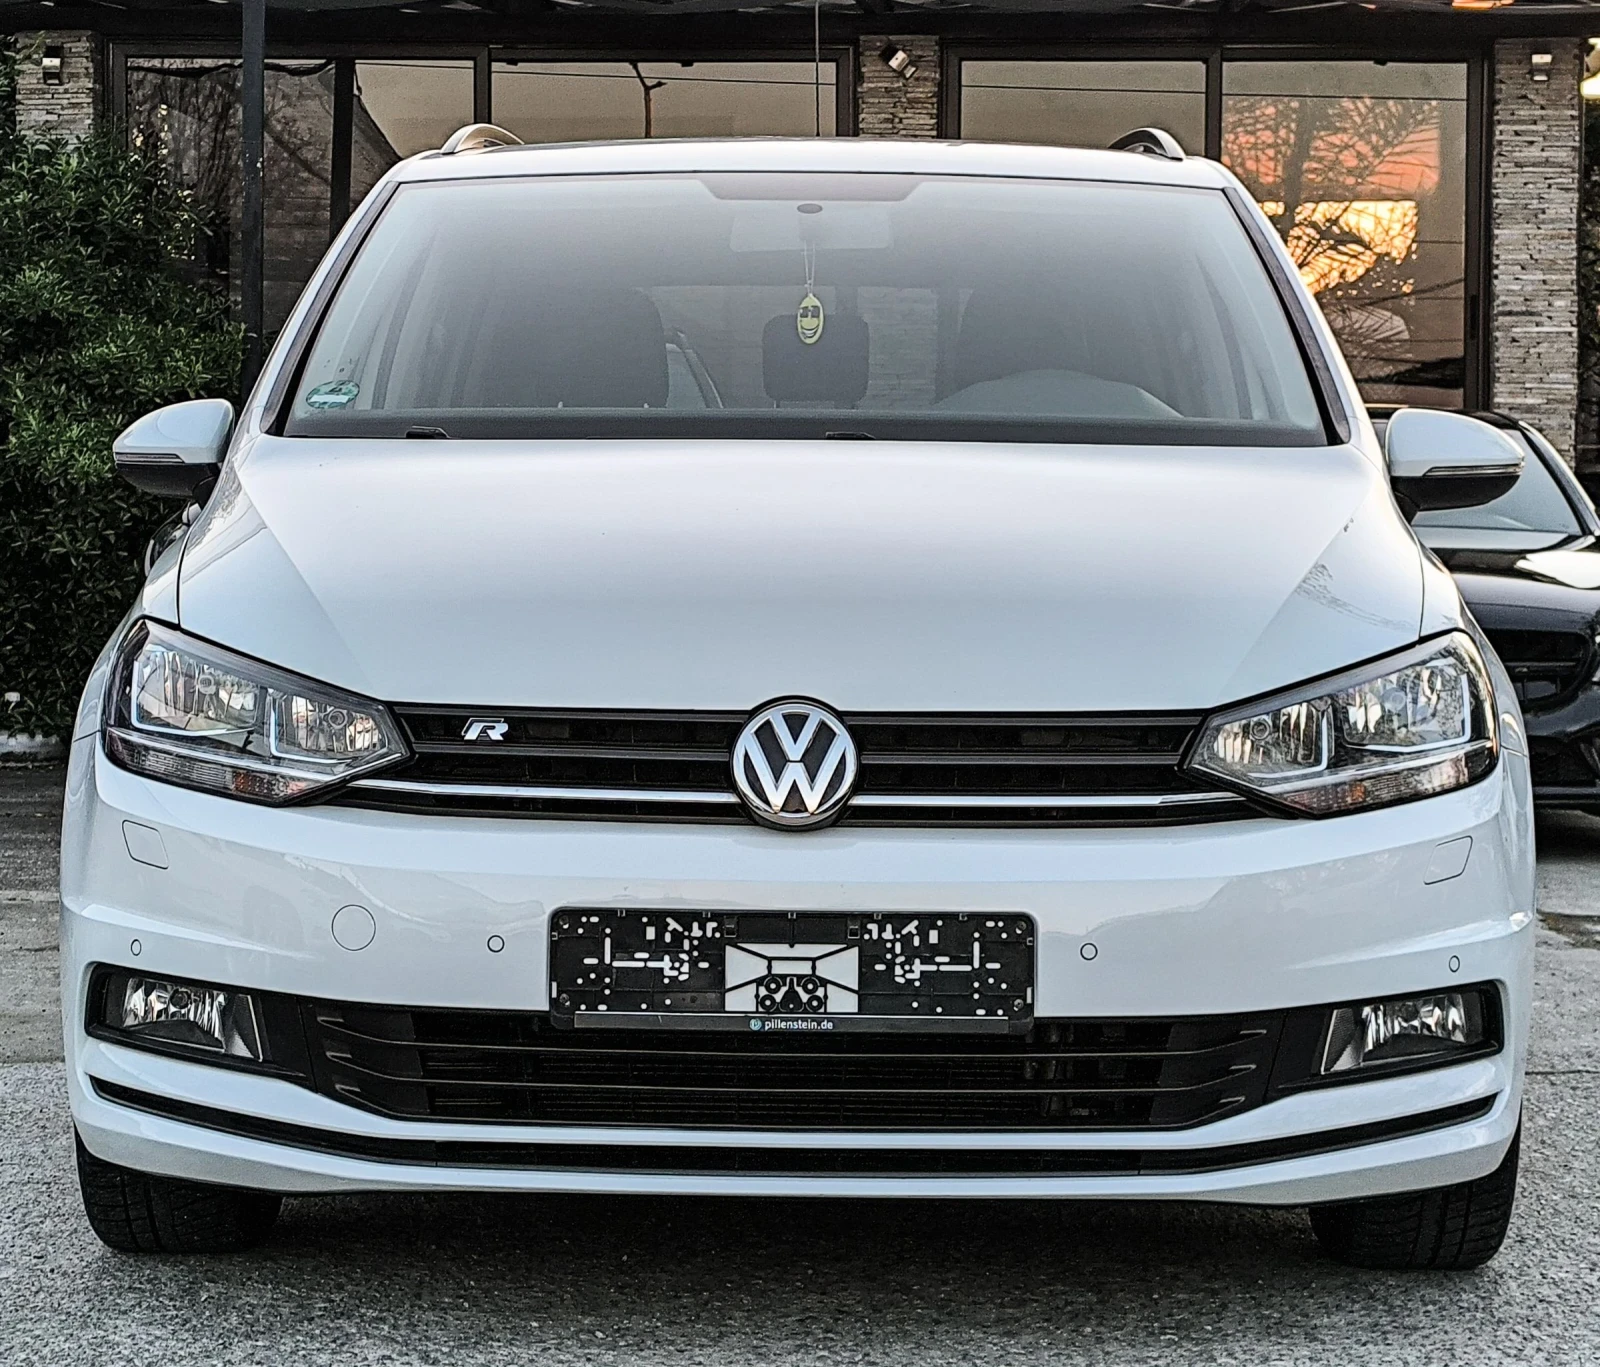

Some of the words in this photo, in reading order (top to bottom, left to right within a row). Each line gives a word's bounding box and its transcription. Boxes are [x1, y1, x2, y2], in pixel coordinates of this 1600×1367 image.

[461, 717, 509, 741] R
[735, 706, 856, 822] VW
[764, 1018, 834, 1031] pillenstein.de
